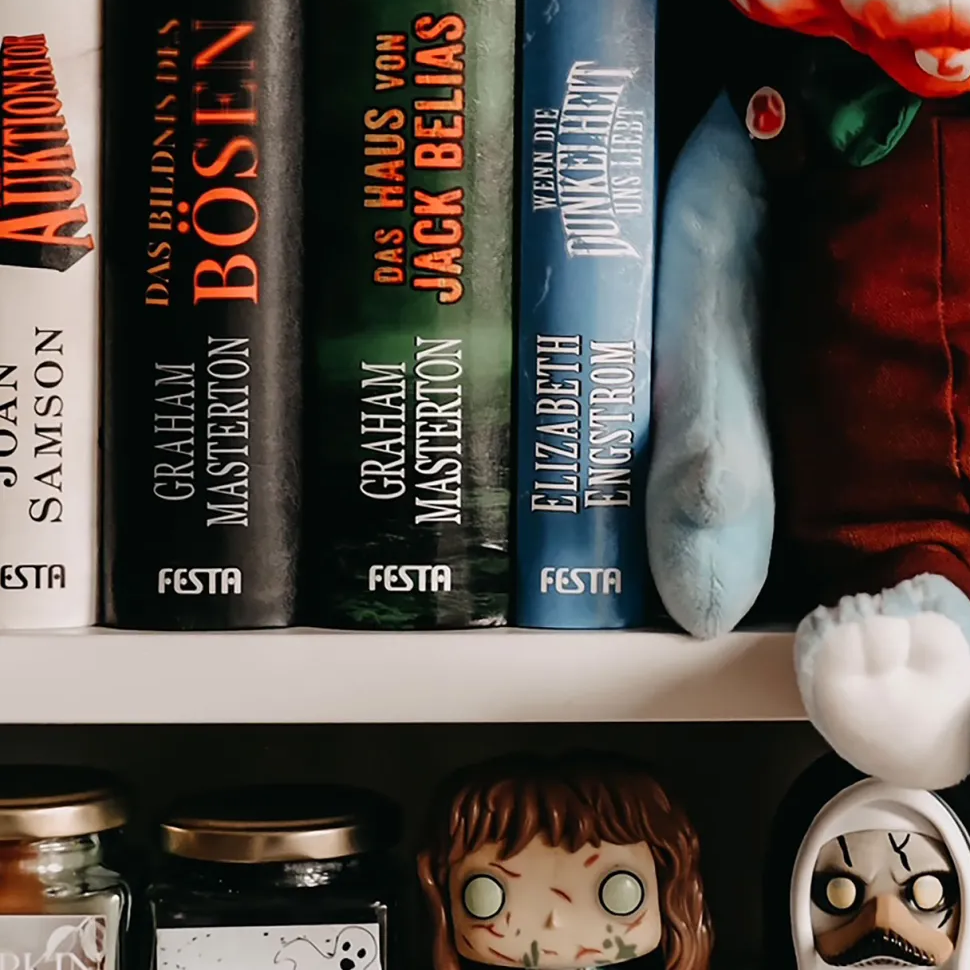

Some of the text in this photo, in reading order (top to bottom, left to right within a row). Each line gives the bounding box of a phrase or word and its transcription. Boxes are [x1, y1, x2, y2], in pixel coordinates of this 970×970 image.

[148, 94, 177, 230] BILDNIS
[177, 20, 259, 306] BÖSEN
[363, 33, 407, 285] DAS HAUS VON
[413, 13, 466, 304] JACK BELIAS
[533, 108, 559, 212] WENN DIE
[556, 60, 642, 259] DUNKELHEIT
[611, 106, 643, 214] UNS LIEBT
[145, 241, 172, 307] DAS
[28, 326, 64, 523] SAMSON
[153, 362, 195, 501] GRAHAM
[206, 335, 250, 527] MASTERTON
[359, 361, 407, 500] GRAHAM
[414, 336, 463, 525] MASTERTON
[531, 334, 582, 514] ELIZABETH
[584, 340, 635, 508] ENGSTROM
[158, 567, 242, 595] FESTA
[368, 564, 451, 592] FESTA
[541, 567, 622, 595] FESTA
